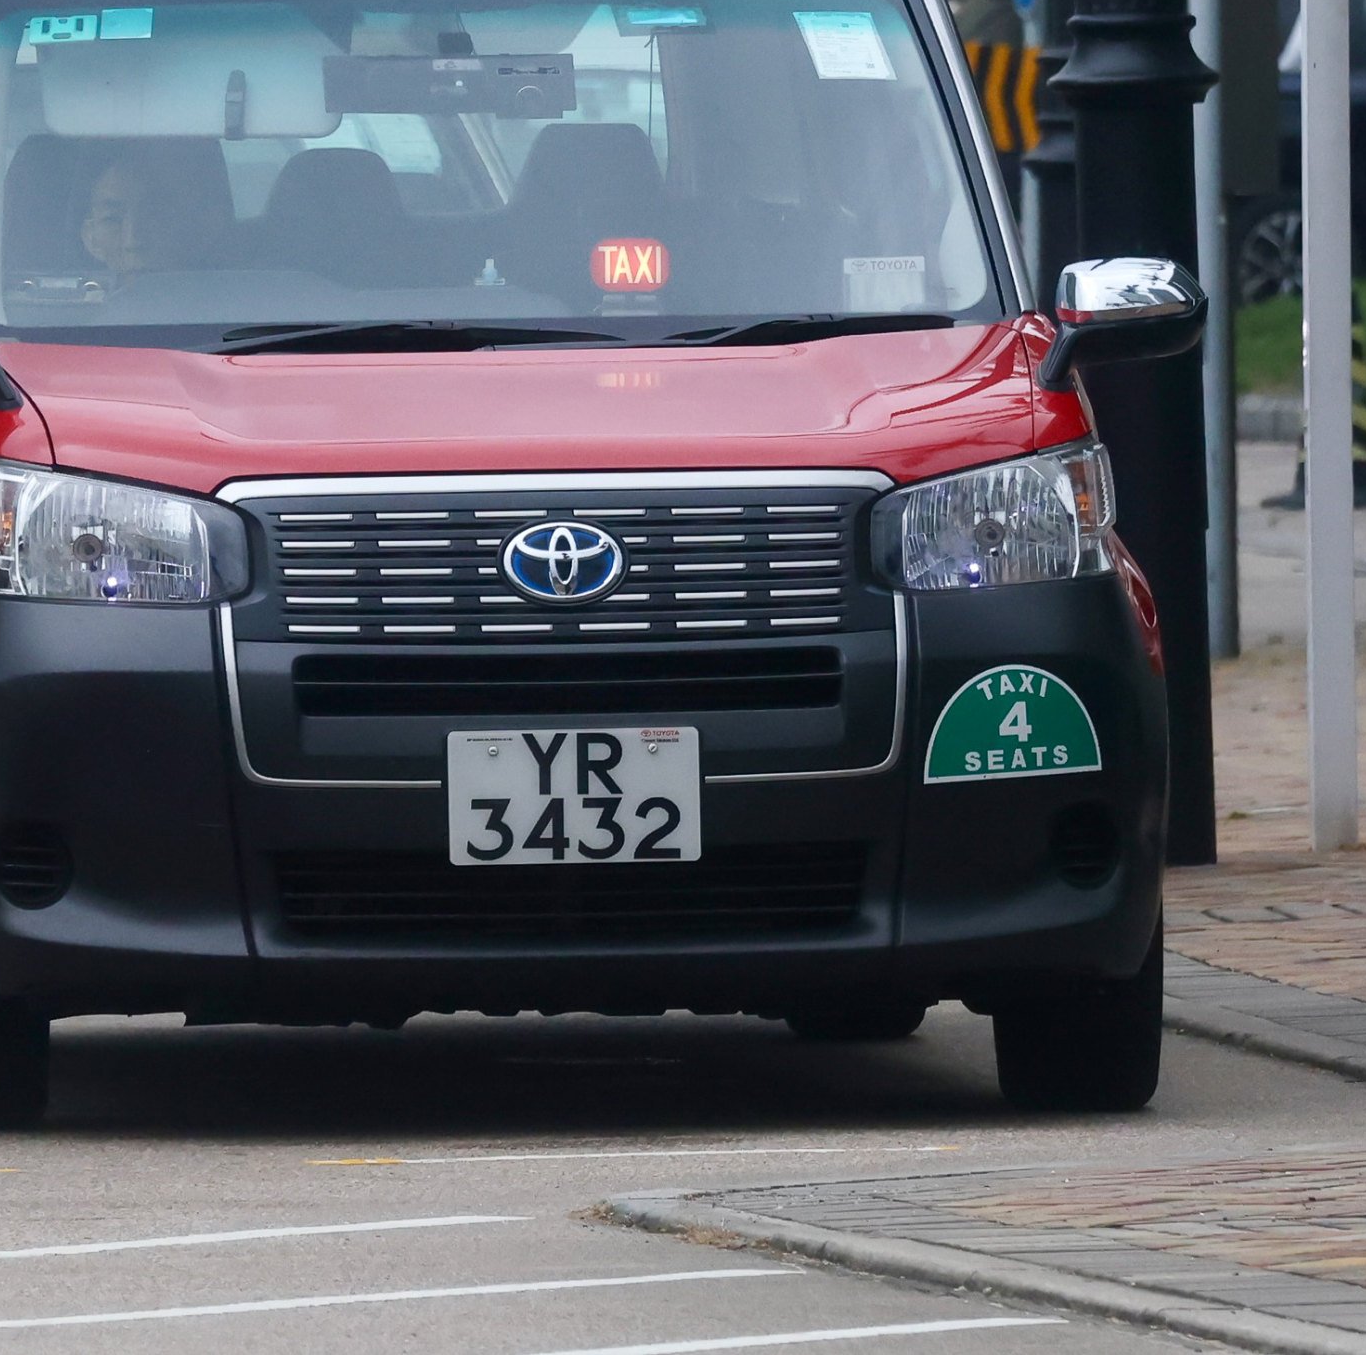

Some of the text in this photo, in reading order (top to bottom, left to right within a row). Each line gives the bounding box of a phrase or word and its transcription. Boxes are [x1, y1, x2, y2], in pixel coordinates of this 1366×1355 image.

[597, 245, 662, 284] TAXI
[870, 258, 917, 271] TOYOTA
[976, 672, 1049, 701] TAXI
[999, 700, 1033, 743] 4
[521, 732, 624, 795] YR
[964, 744, 1069, 772] SEATS
[466, 796, 681, 861] 3432
